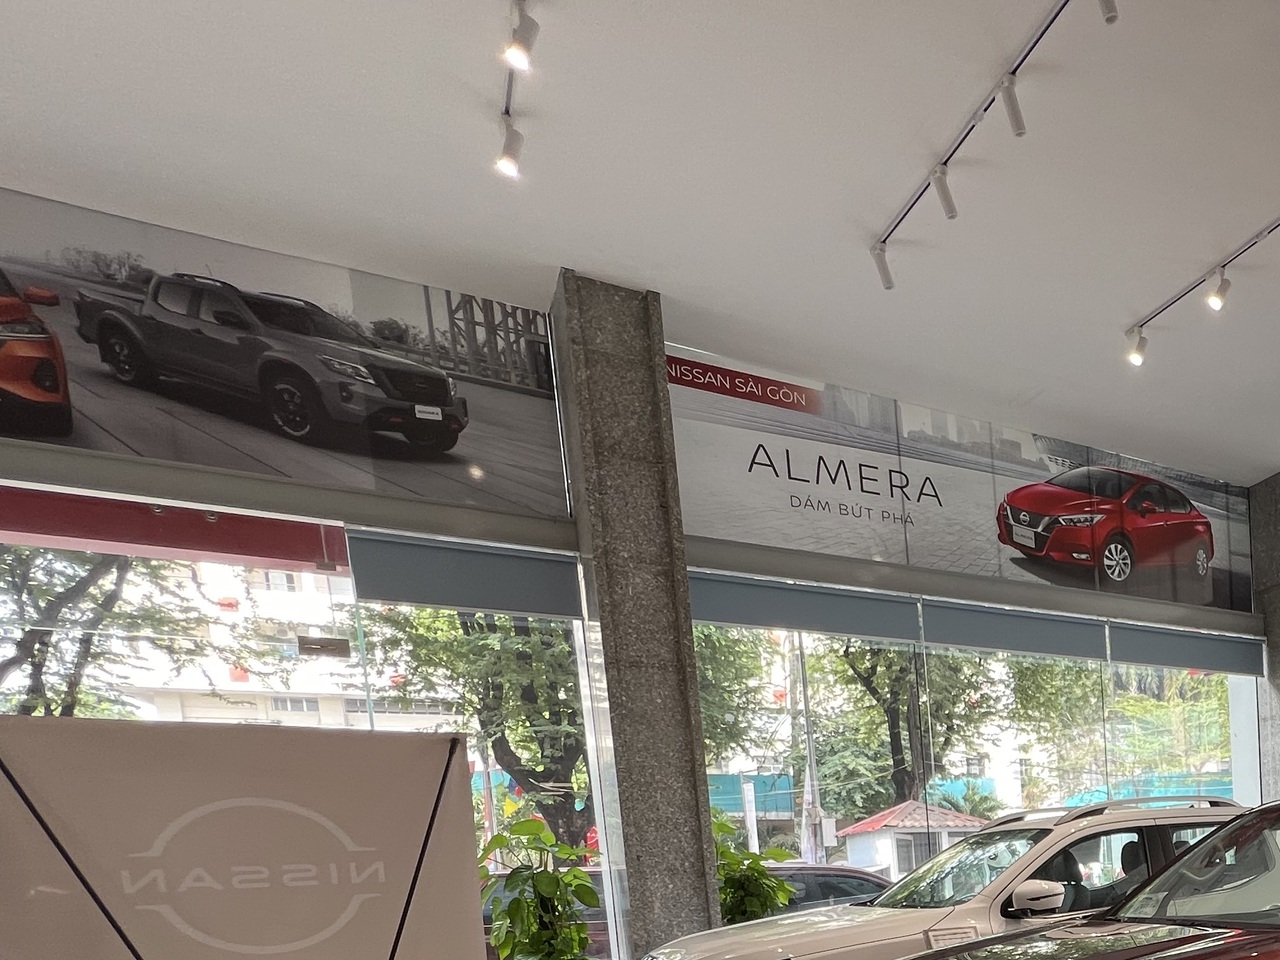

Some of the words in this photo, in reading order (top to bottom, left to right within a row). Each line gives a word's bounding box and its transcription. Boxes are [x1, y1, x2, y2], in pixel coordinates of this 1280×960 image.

[666, 362, 731, 389] NISSAN
[735, 377, 762, 396] SÀI
[766, 385, 806, 406] GÒN
[748, 443, 943, 508] ALMERA
